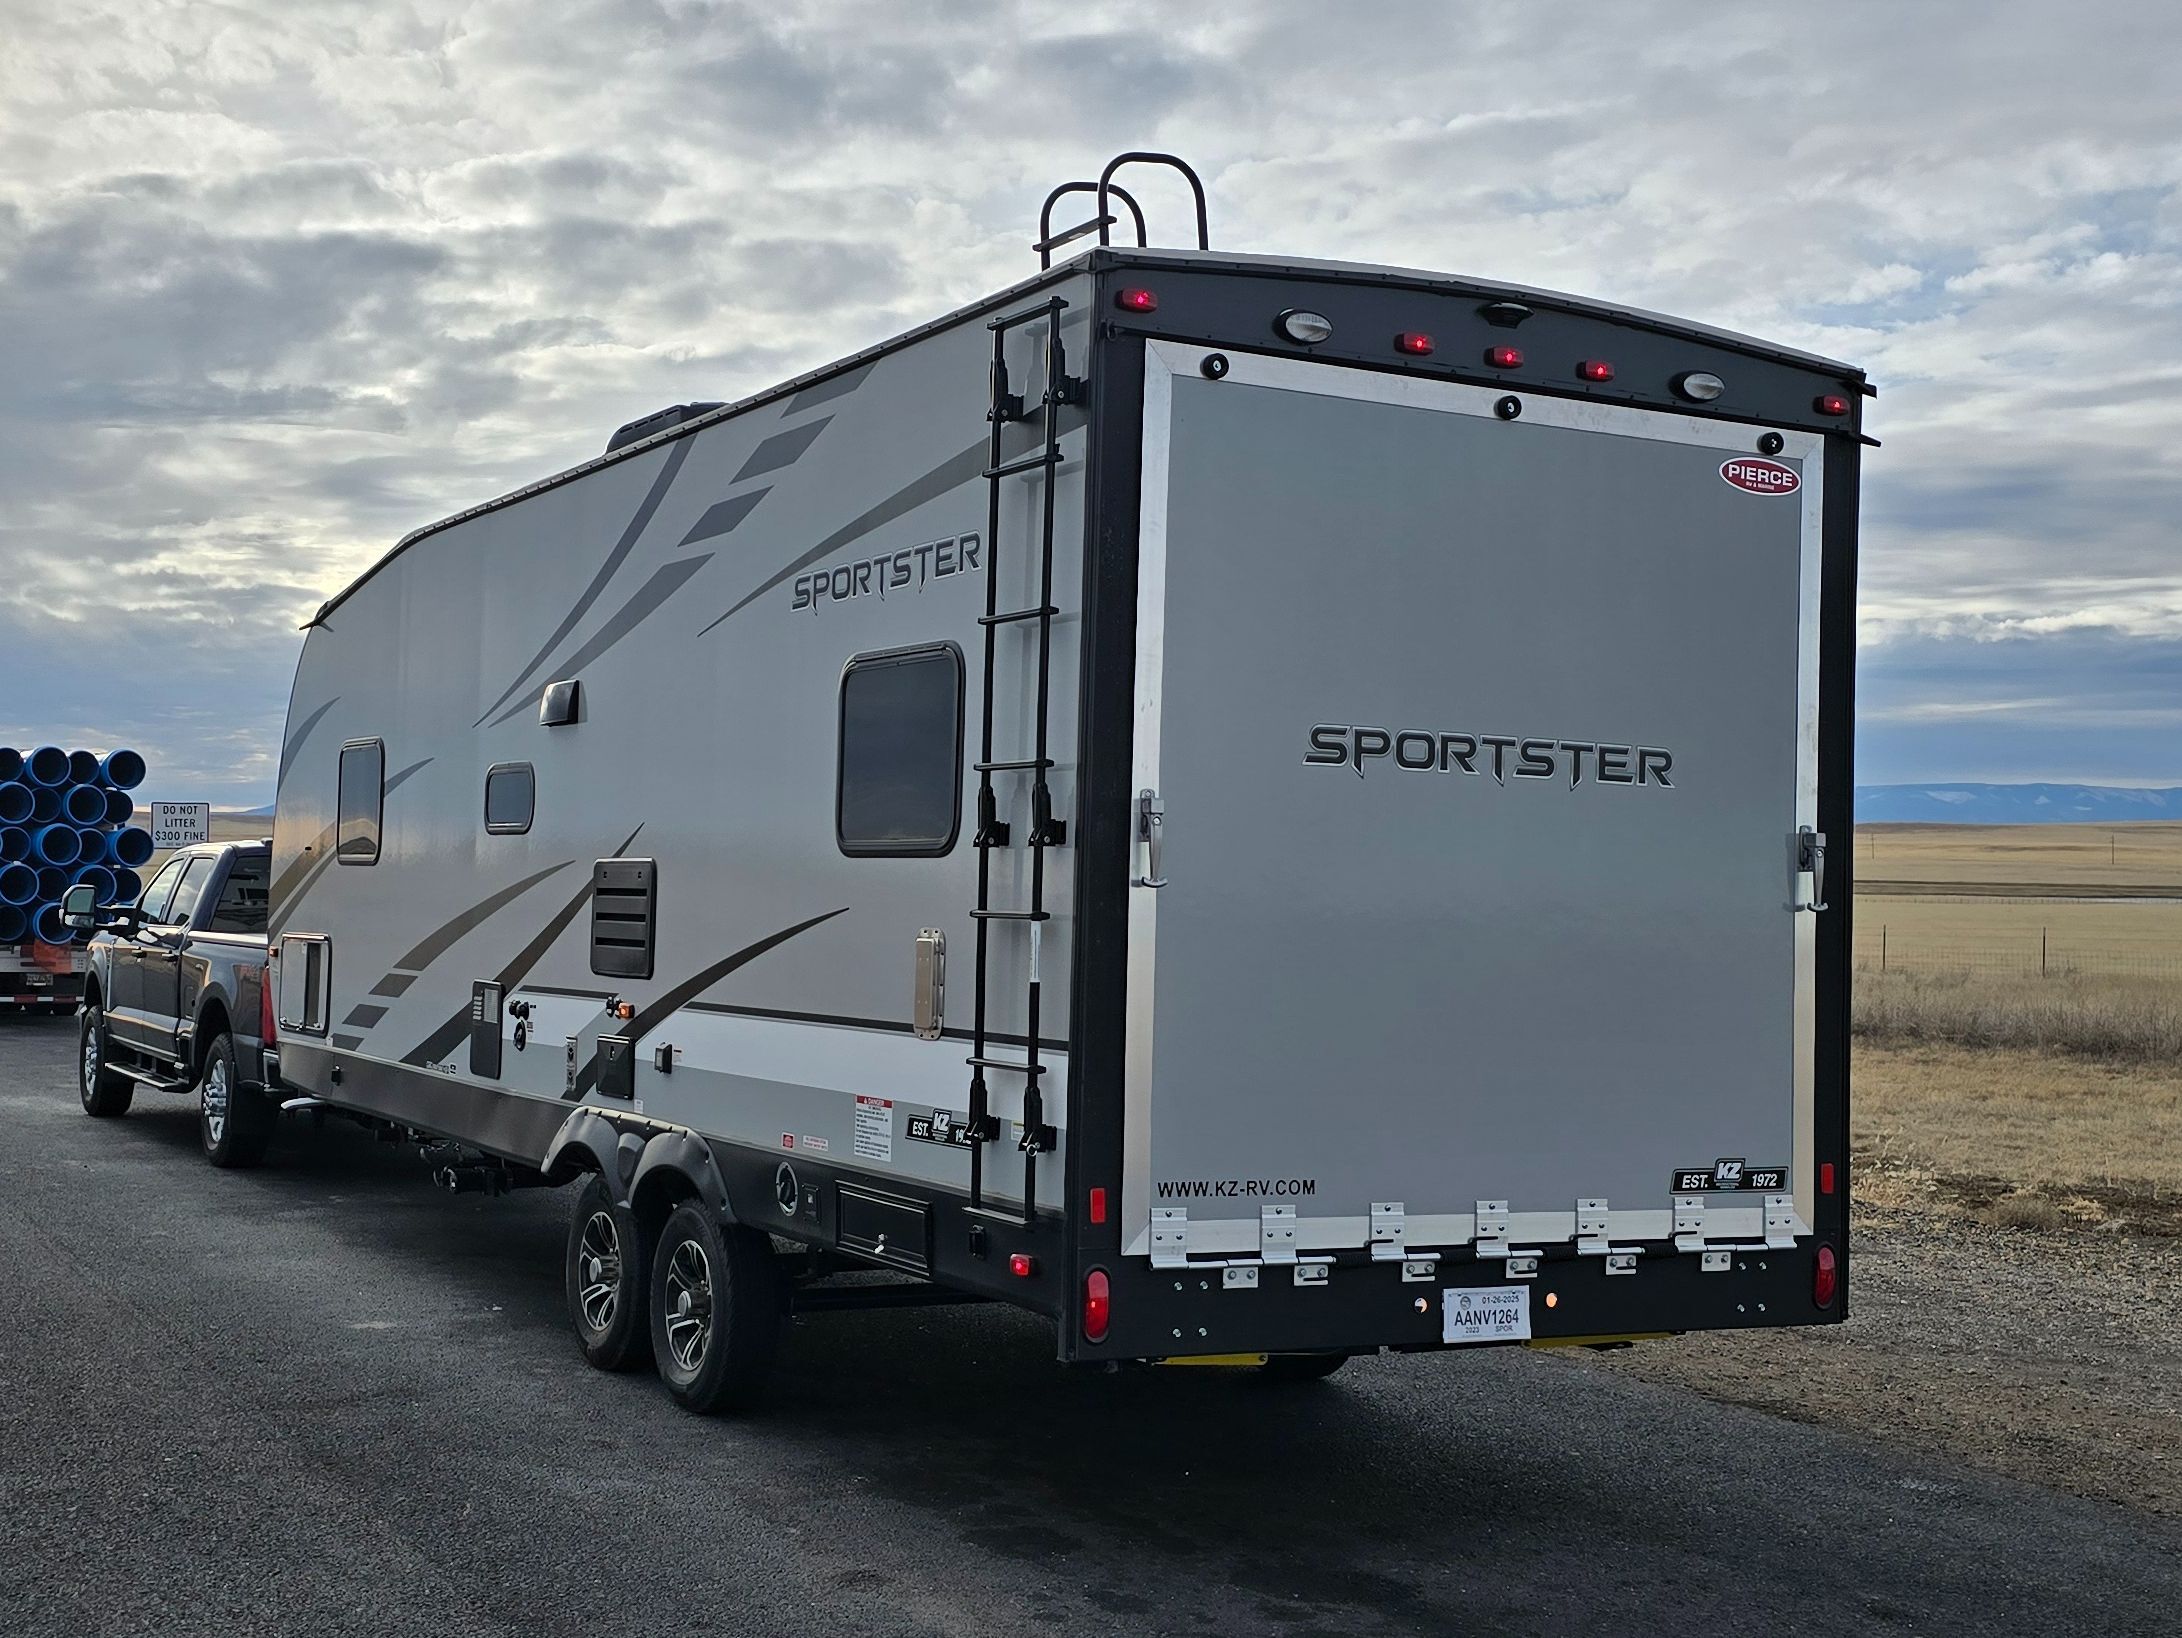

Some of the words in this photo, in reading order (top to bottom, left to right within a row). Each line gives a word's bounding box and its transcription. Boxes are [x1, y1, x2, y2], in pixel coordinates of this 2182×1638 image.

[1728, 464, 1793, 487] PIERCE
[791, 530, 982, 616] SPORTSTER
[1302, 723, 1675, 792] SPORTSTER
[163, 805, 176, 815] DO
[180, 805, 198, 815] NOT
[165, 818, 196, 828] LITTER
[155, 830, 180, 841] $300
[184, 831, 205, 841] FINE
[912, 1121, 929, 1137] EST.
[933, 1112, 950, 1131] KZ
[955, 1128, 972, 1145] 19
[1682, 1175, 1709, 1189] EST.
[1716, 1162, 1742, 1179] KZ
[1752, 1173, 1778, 1187] 1972
[1157, 1179, 1316, 1198] WWW.KZ-RV.COM
[1481, 1295, 1520, 1304] 01-26-2025
[1454, 1308, 1519, 1326] AANV1264
[1495, 1325, 1513, 1333] SPOR
